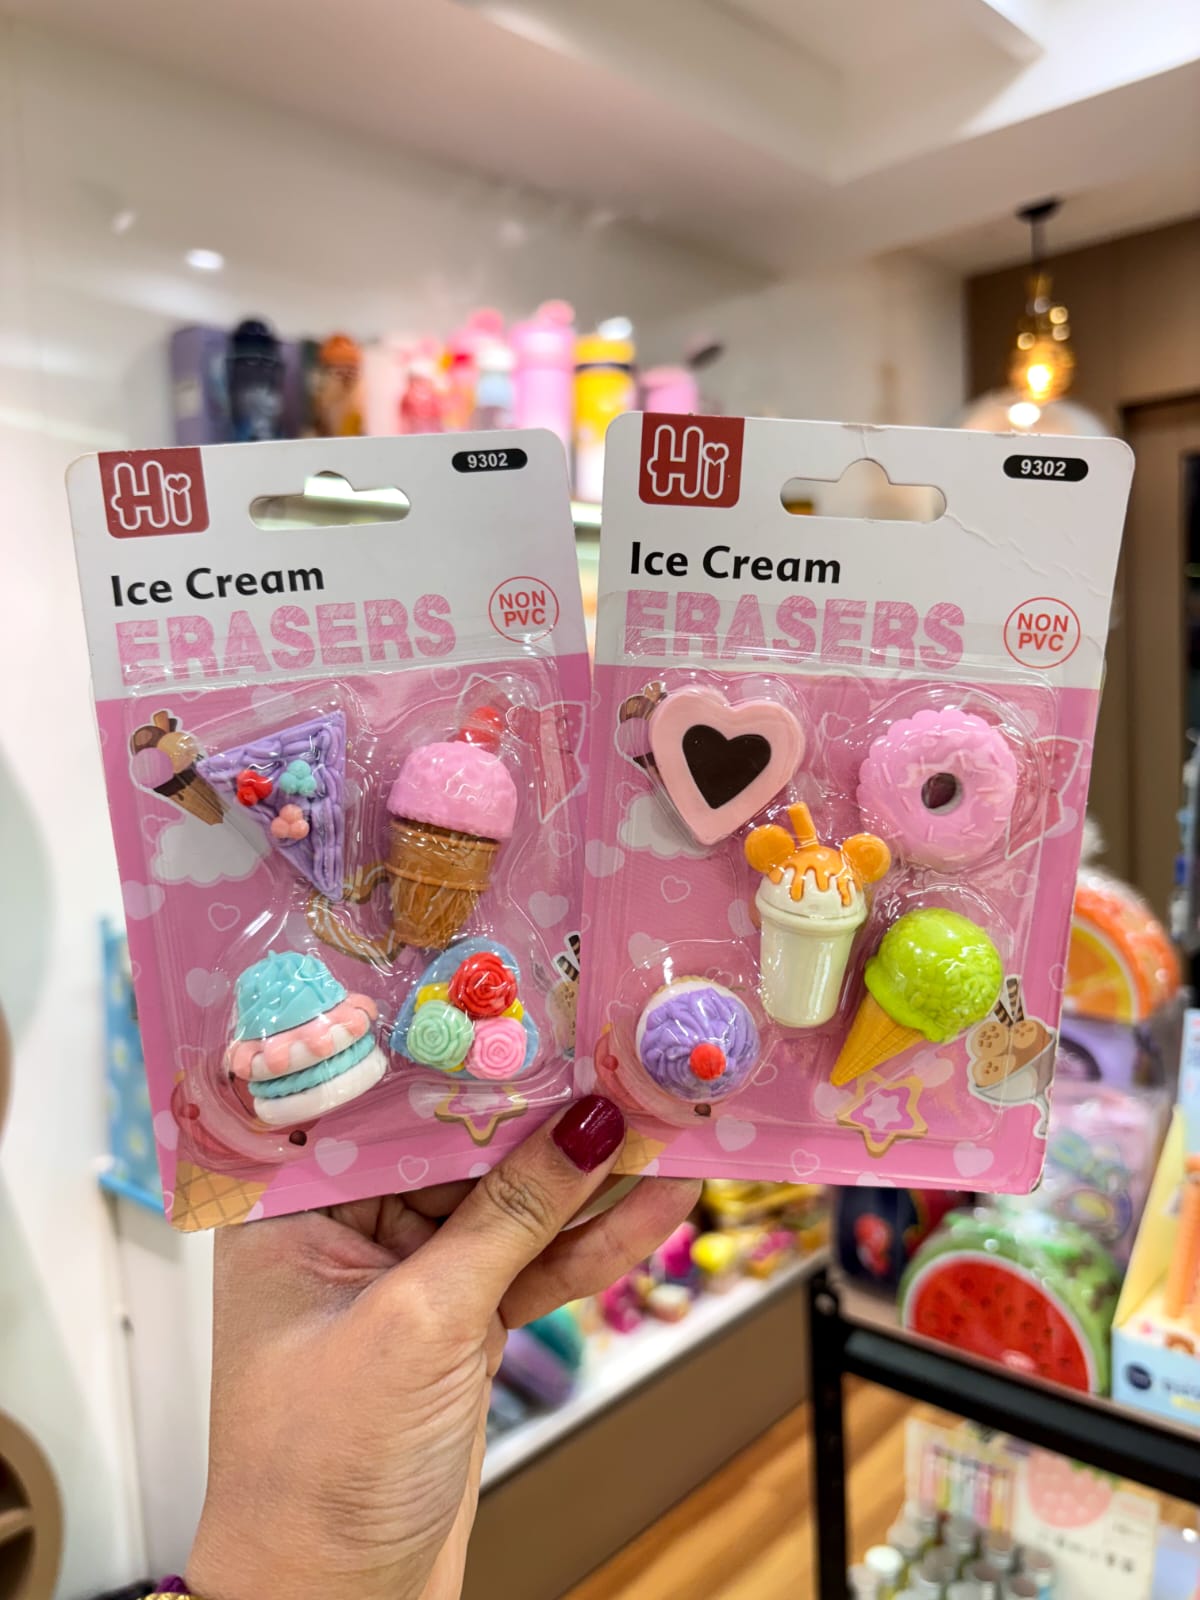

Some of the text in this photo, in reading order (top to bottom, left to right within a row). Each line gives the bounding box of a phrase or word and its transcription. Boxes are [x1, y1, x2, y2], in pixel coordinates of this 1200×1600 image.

[467, 453, 509, 469] 9302
[647, 425, 729, 499] Hi
[1020, 459, 1067, 477] 9302
[111, 460, 193, 530] Hi
[630, 541, 841, 584] Ice Cream
[111, 567, 325, 607] Ice Cream
[498, 590, 547, 611] NON
[504, 608, 547, 628] PVC
[624, 589, 966, 670] ERASERS
[1017, 613, 1069, 633] NON
[115, 594, 457, 686] ERASERS
[1019, 631, 1065, 652] PVC
